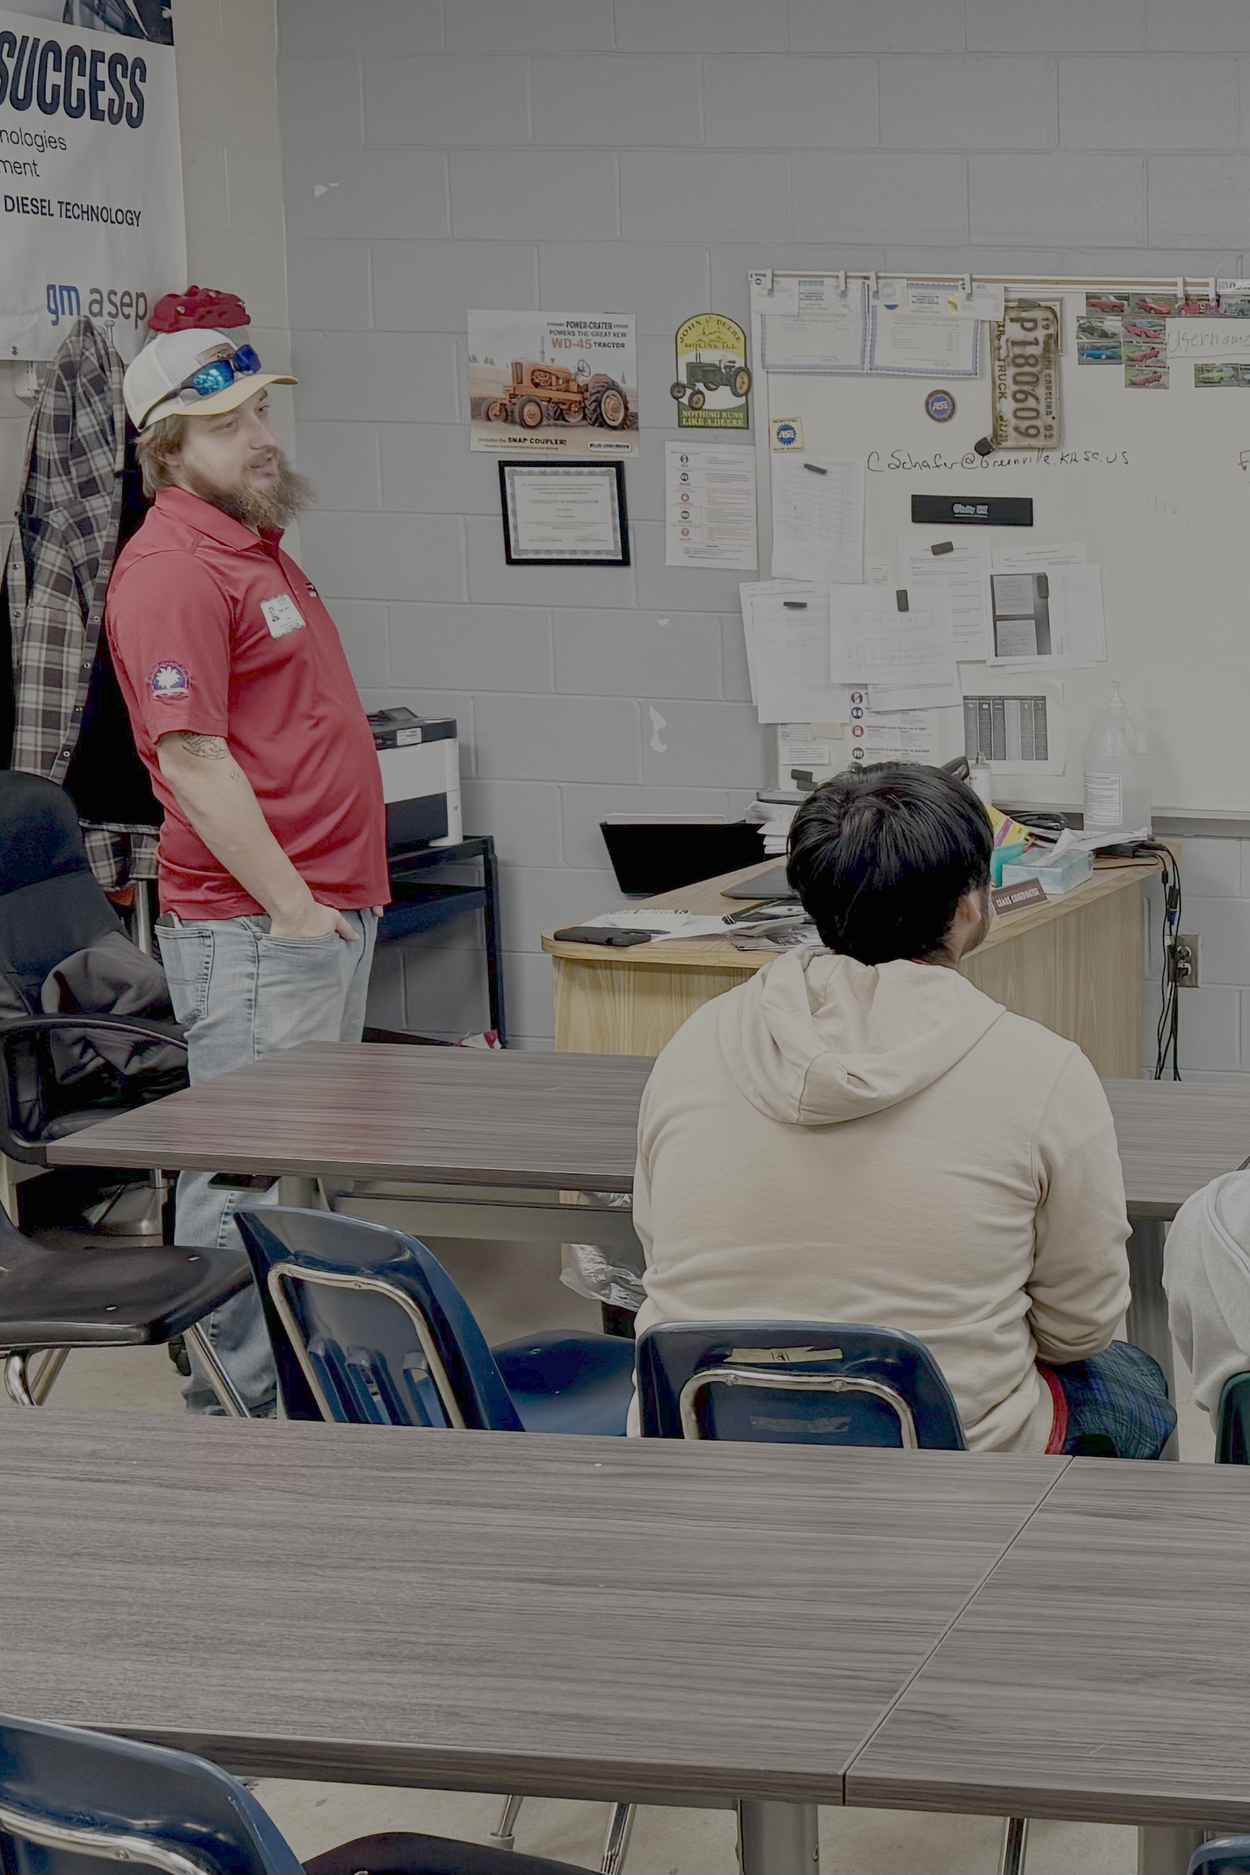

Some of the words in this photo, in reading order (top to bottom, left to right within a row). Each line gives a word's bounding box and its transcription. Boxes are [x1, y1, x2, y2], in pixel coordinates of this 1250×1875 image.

[0, 30, 147, 129] SUCCESS
[4, 194, 54, 217] DIESEL
[57, 200, 141, 227] TECHNOLOGY
[46, 283, 80, 326] gm
[88, 287, 148, 330] asep
[551, 338, 592, 350] WD-45
[593, 341, 626, 349] TRACTOR
[680, 318, 702, 344] JOHN
[716, 319, 741, 343] DEERE
[998, 357, 1007, 400] TRUCK
[1009, 317, 1040, 439] P180609
[778, 430, 795, 438] ASE
